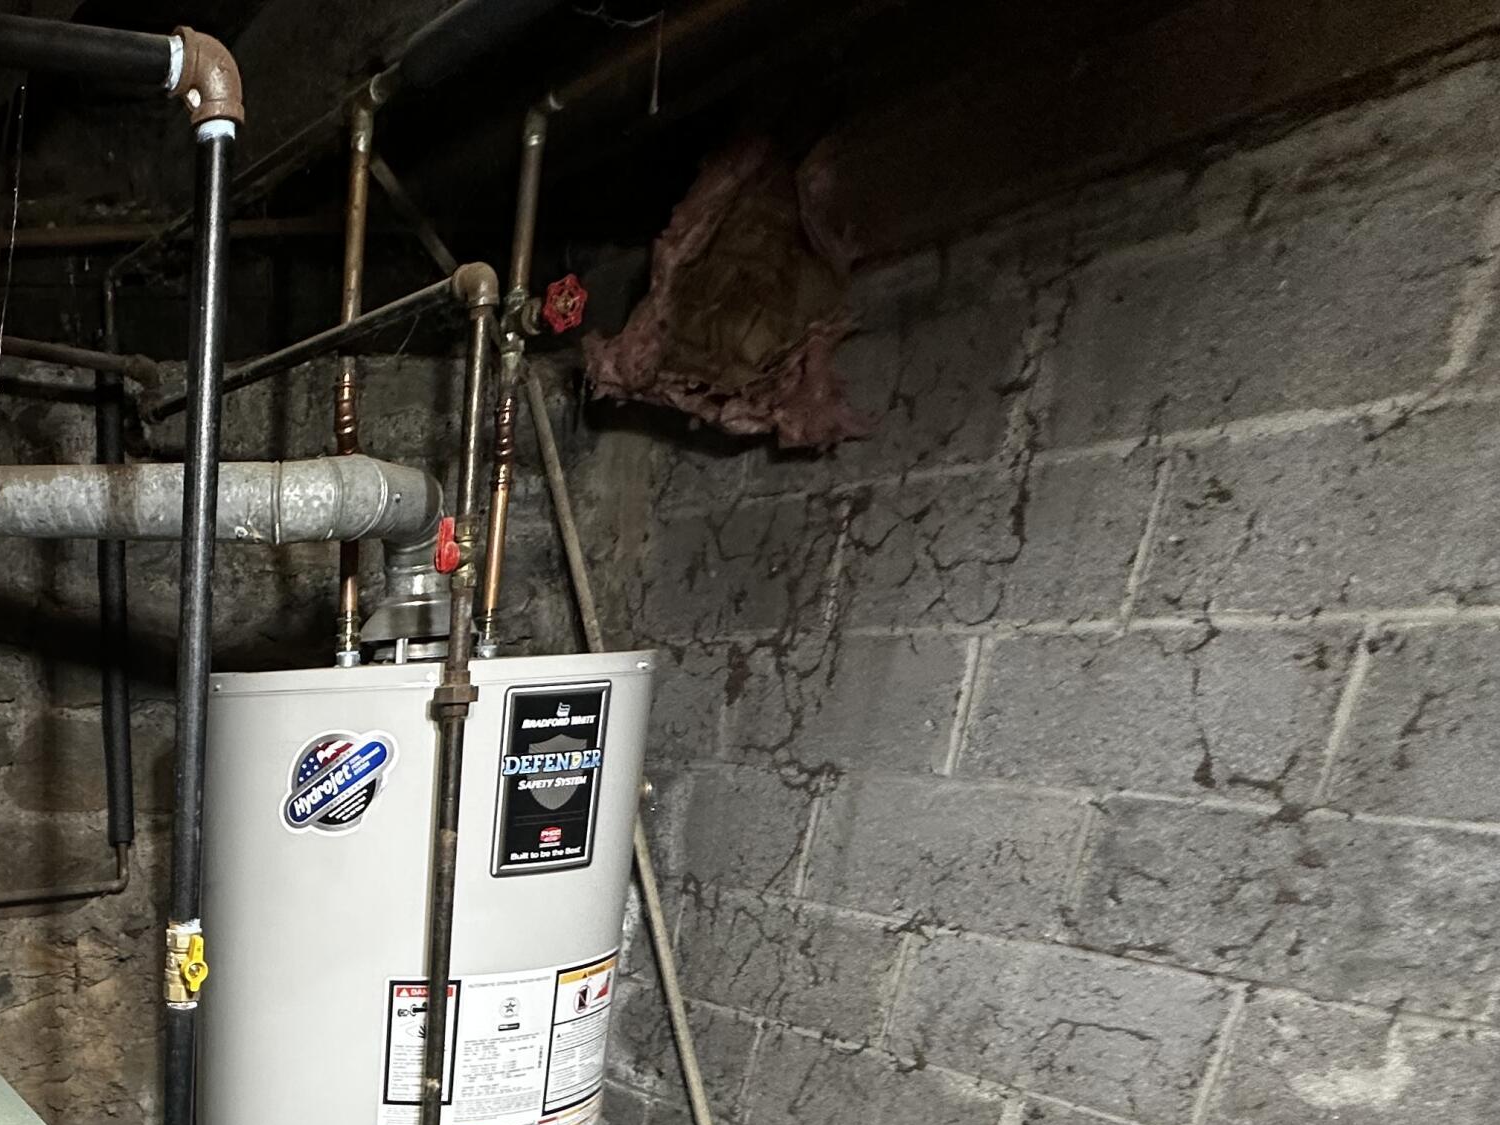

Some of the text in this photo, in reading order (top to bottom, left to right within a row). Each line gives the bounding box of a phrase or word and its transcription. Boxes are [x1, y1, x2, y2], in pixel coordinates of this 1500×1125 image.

[521, 717, 570, 729] BRADFORD
[503, 749, 601, 775] DEFENDER
[293, 763, 353, 817] Hydrojet
[517, 775, 588, 790] SAFETY SYSTEM
[530, 851, 539, 859] to
[540, 850, 551, 858] be
[552, 848, 564, 857] the
